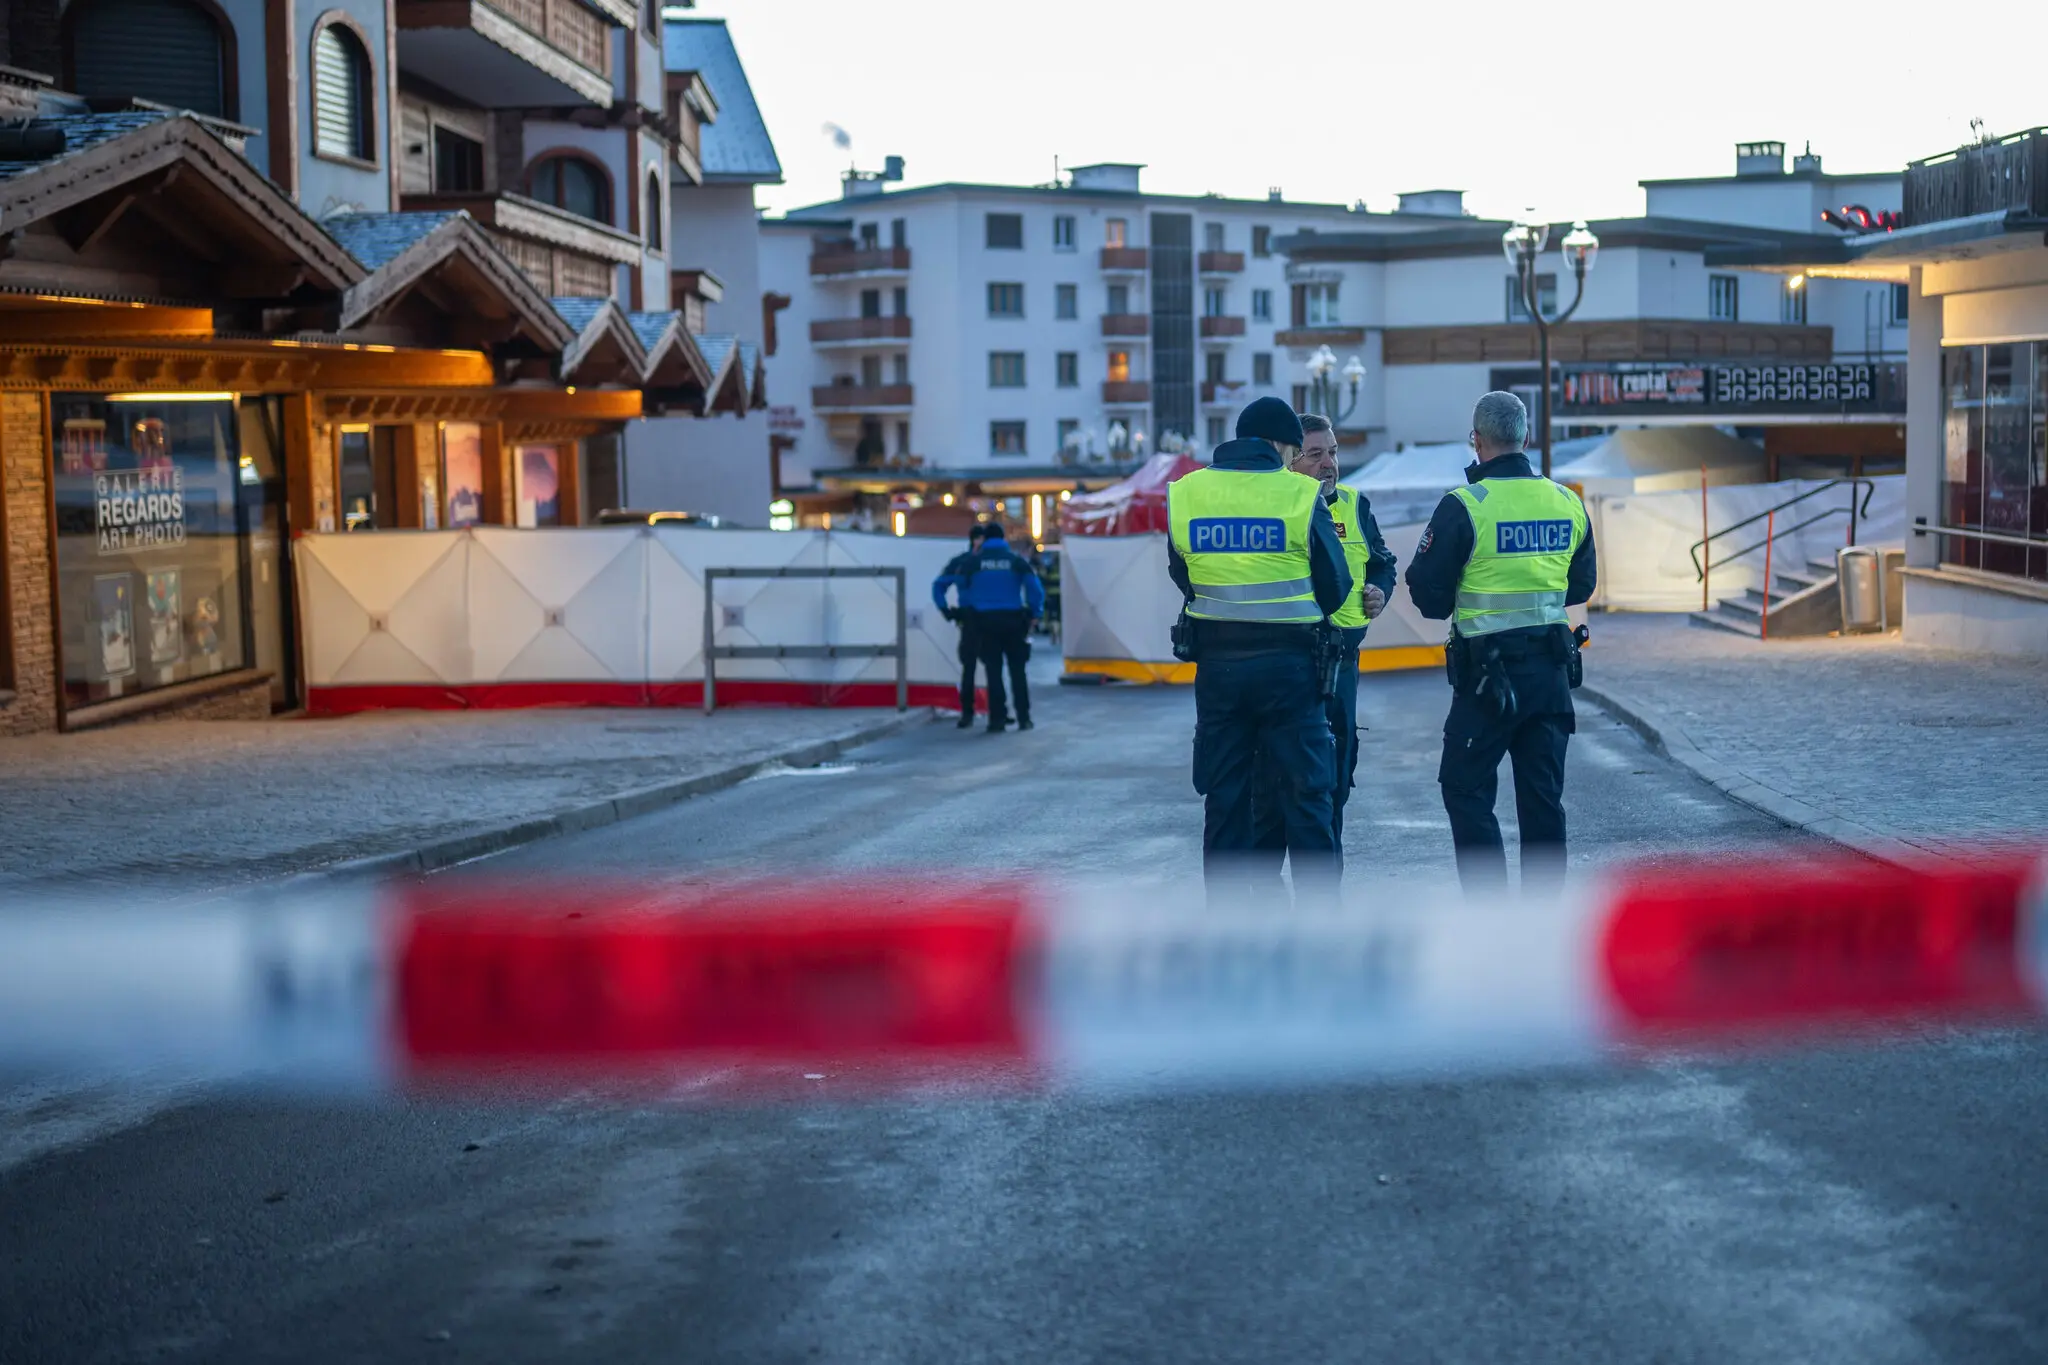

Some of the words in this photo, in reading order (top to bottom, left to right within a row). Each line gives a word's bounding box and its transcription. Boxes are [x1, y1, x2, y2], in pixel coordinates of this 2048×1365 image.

[98, 469, 181, 496] GALERIE
[99, 492, 182, 527] REGARDS
[101, 527, 128, 550] ART
[135, 521, 183, 546] PHOTO
[1196, 524, 1278, 549] POLICE
[1500, 524, 1570, 549] POLICE
